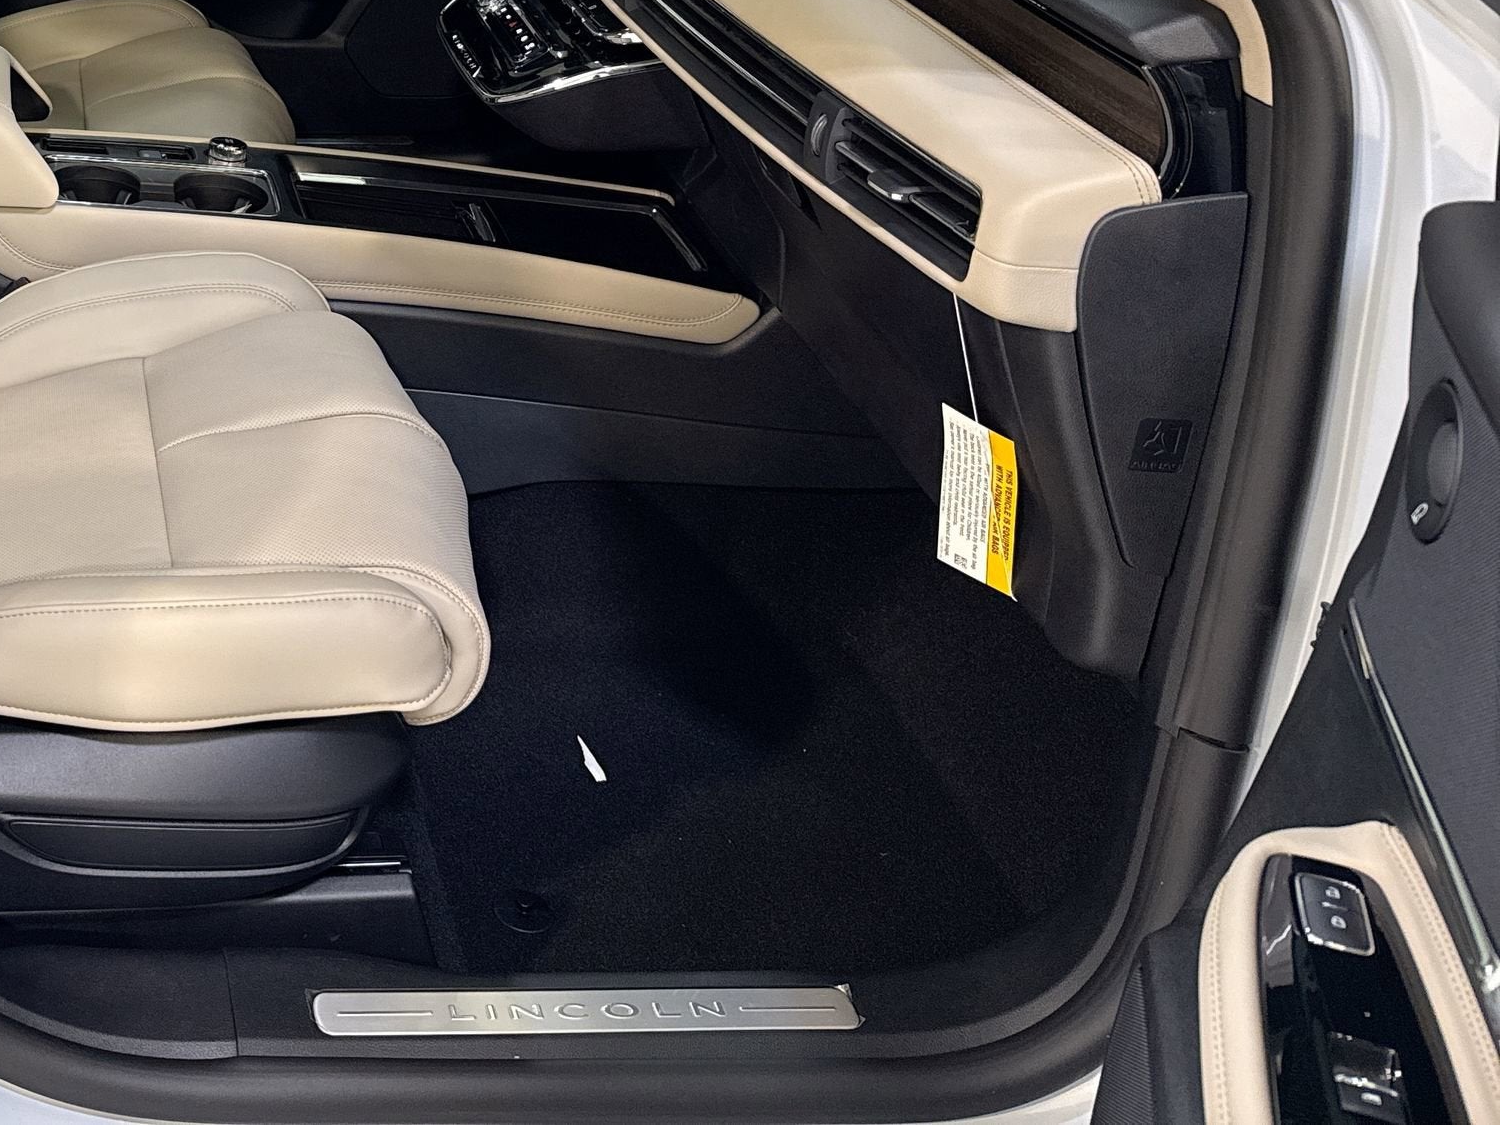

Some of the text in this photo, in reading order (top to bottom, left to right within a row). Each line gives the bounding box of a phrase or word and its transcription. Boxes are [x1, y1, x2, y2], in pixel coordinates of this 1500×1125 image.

[995, 463, 1003, 483] WITH
[1003, 516, 1010, 526] IS
[991, 534, 999, 556] BAGS
[448, 1001, 727, 1021] LINCOLN
